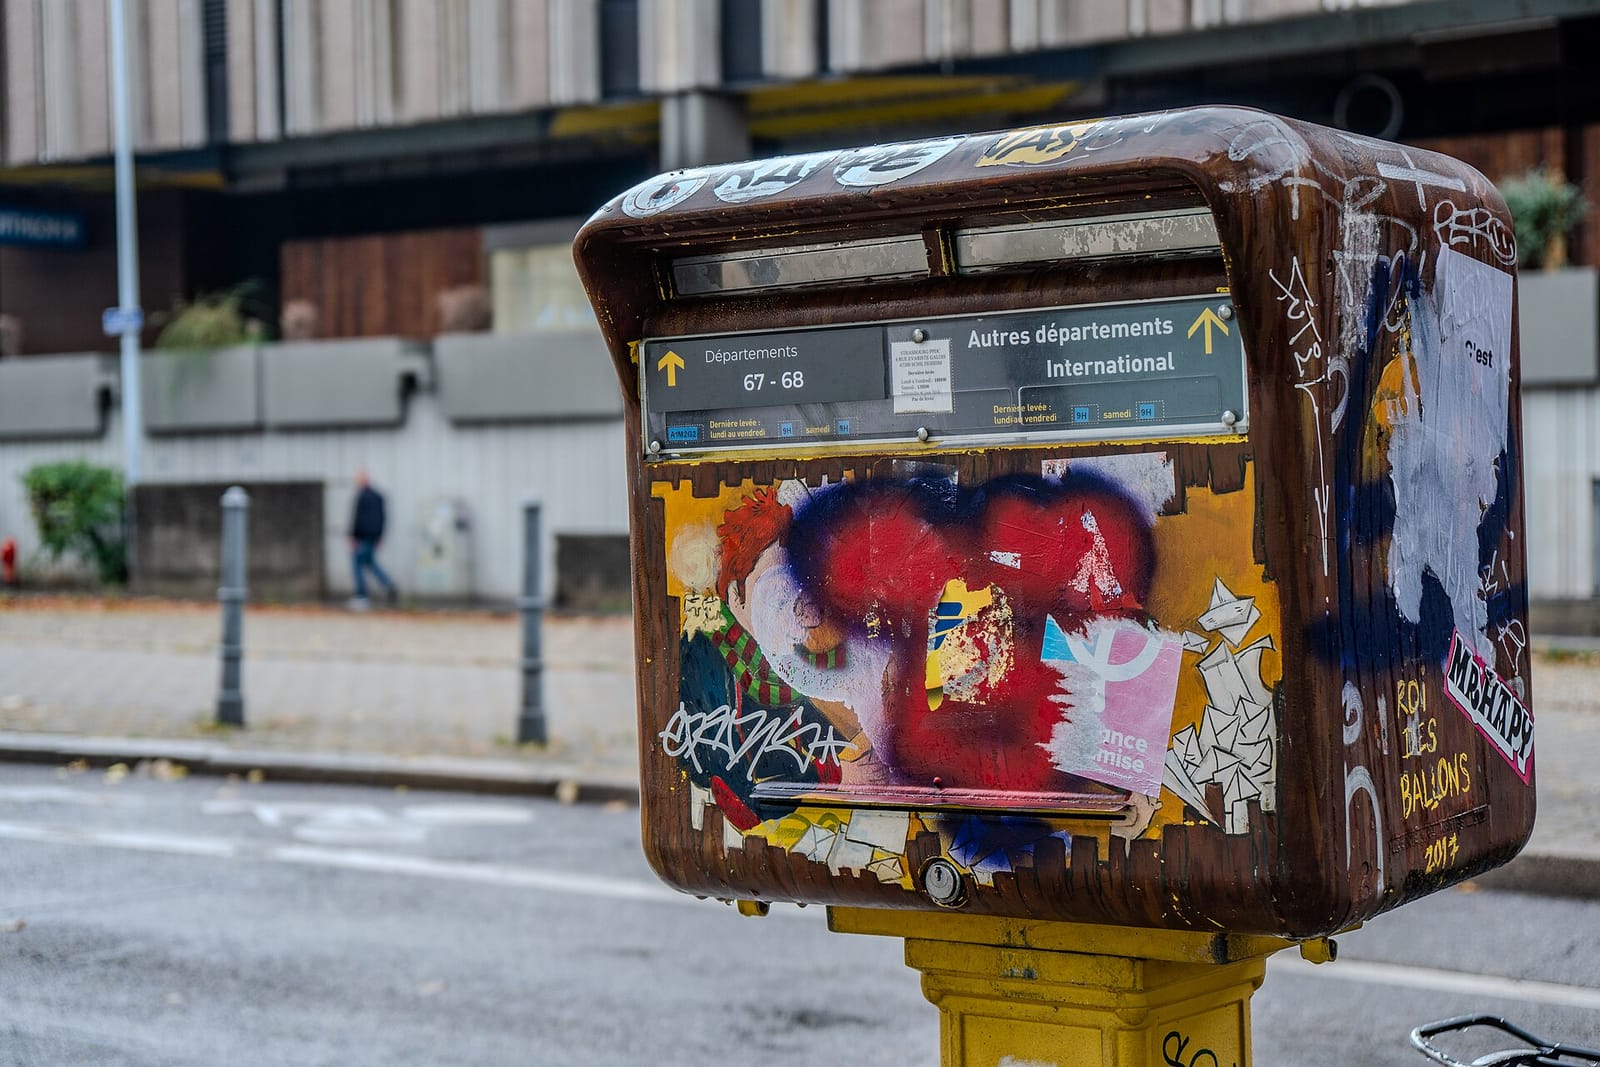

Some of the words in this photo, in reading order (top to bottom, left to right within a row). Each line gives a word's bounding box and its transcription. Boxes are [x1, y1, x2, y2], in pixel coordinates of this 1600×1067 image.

[967, 329, 1030, 348] Autres
[1035, 317, 1174, 347] départements
[704, 345, 798, 364] Départements
[1046, 352, 1175, 378] International
[743, 373, 765, 391] 67
[781, 371, 804, 389] 68
[1027, 402, 1047, 412] levée
[1024, 414, 1057, 423] vendredi
[1076, 412, 1087, 420] 9H
[1103, 409, 1132, 419] samedi
[1140, 409, 1151, 417] 9H
[709, 420, 738, 429] Dernière
[739, 418, 757, 427] levée
[710, 430, 727, 439] lundi
[737, 428, 766, 438] vendredi
[782, 427, 792, 435] 9H
[805, 425, 830, 434] samedi
[1400, 752, 1471, 819] BALLONS
[1425, 833, 1460, 874] 2017
